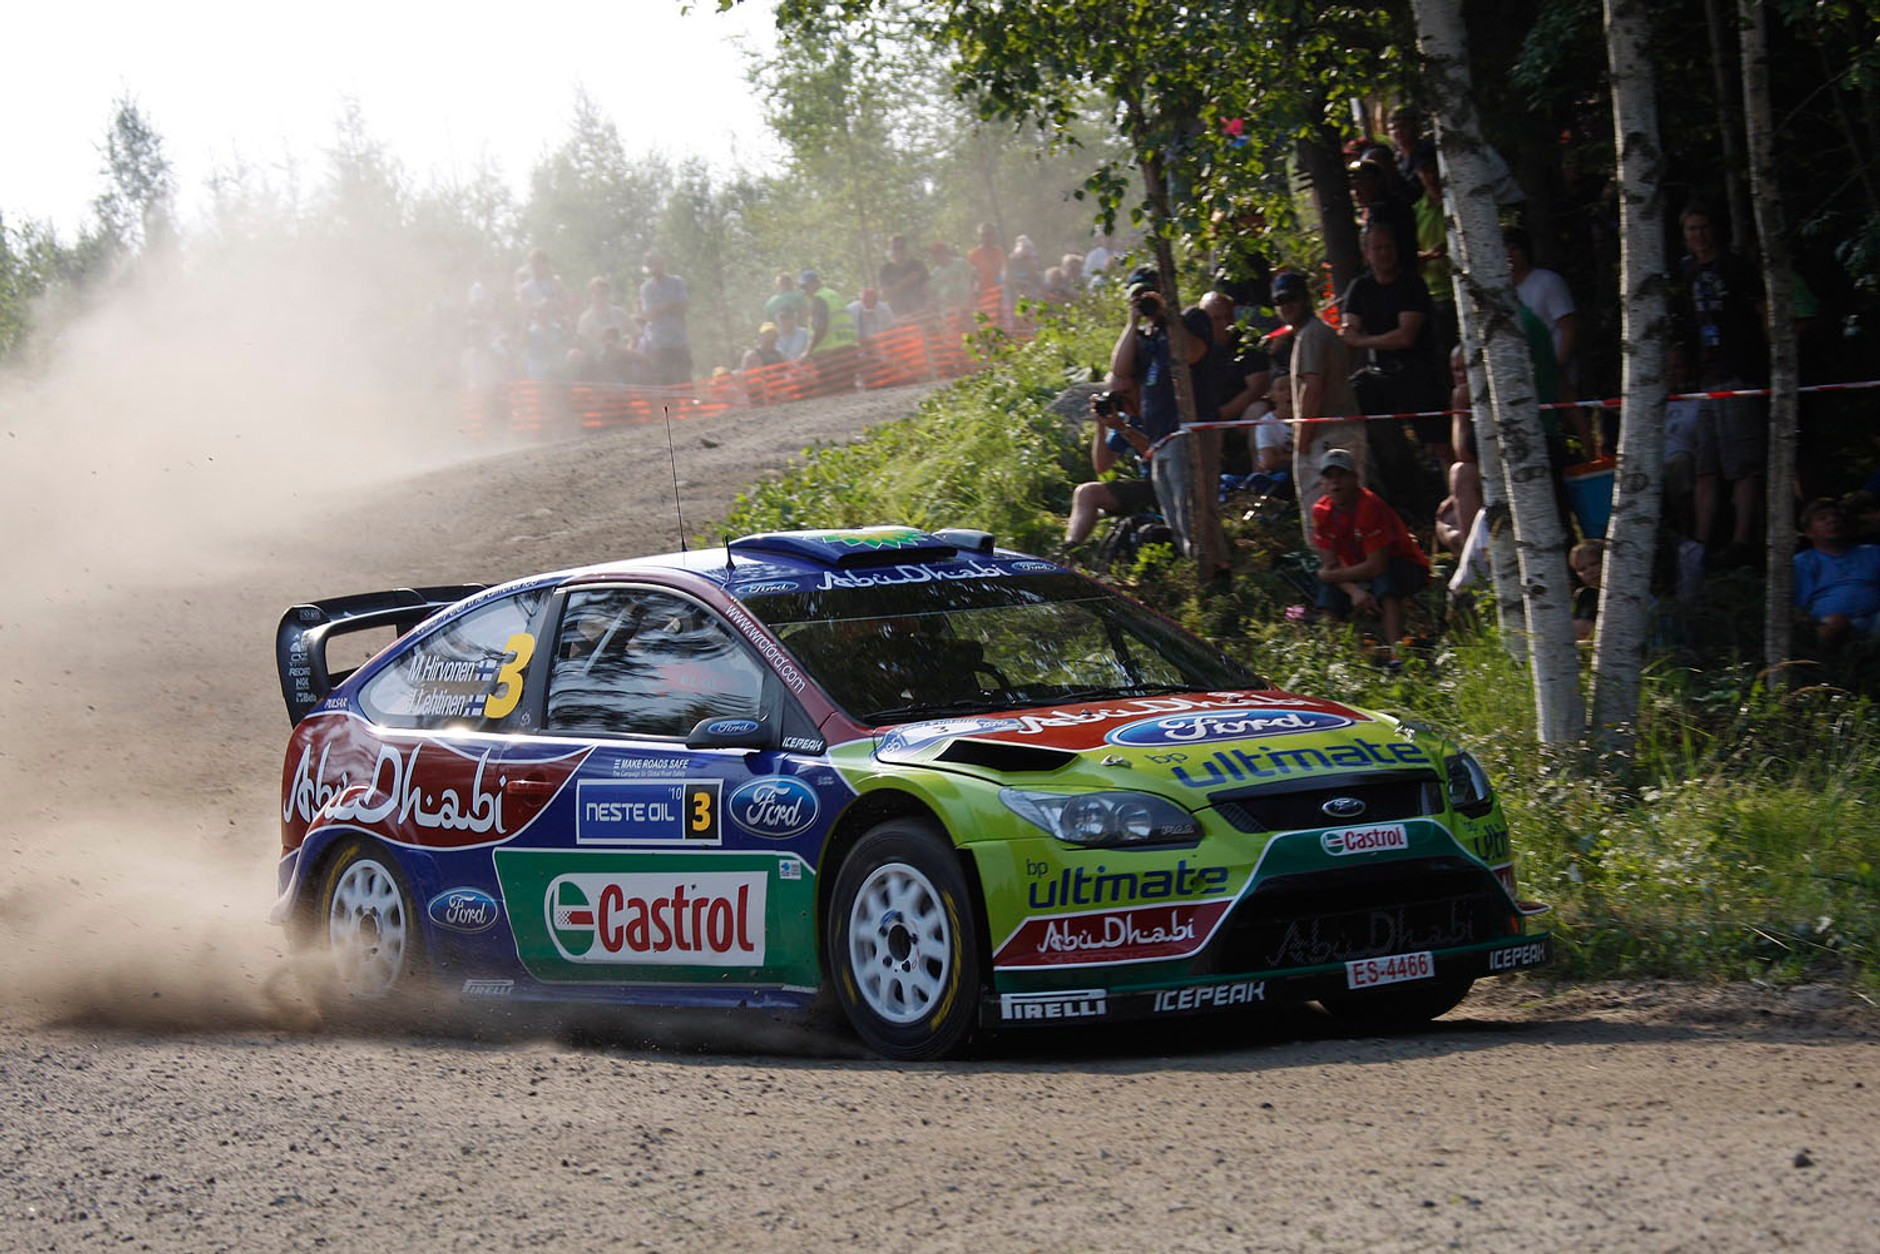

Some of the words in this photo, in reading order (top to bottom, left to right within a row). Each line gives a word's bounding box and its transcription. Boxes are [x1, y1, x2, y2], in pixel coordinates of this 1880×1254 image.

[725, 604, 806, 693] www.wrcford.com
[422, 655, 477, 682] Hirvonen
[484, 632, 535, 719] 3
[716, 721, 750, 733] Ford
[1157, 712, 1317, 740] Ford
[1144, 751, 1188, 764] bp
[1171, 738, 1431, 788] ultimate
[586, 803, 646, 821] NESTE
[648, 803, 675, 821] OIL
[692, 791, 711, 831] 3
[746, 785, 804, 827] Ford
[1344, 827, 1404, 851] Castrol
[1026, 858, 1048, 876] bp
[1029, 860, 1229, 908] ultimate
[446, 894, 488, 925] Ford
[599, 883, 755, 953] Castrol
[1354, 954, 1429, 985] ES-4466
[1489, 943, 1545, 971] ICEPEAK
[1001, 989, 1107, 1020] PIRELLI
[1154, 981, 1265, 1012] ICEPEAK
